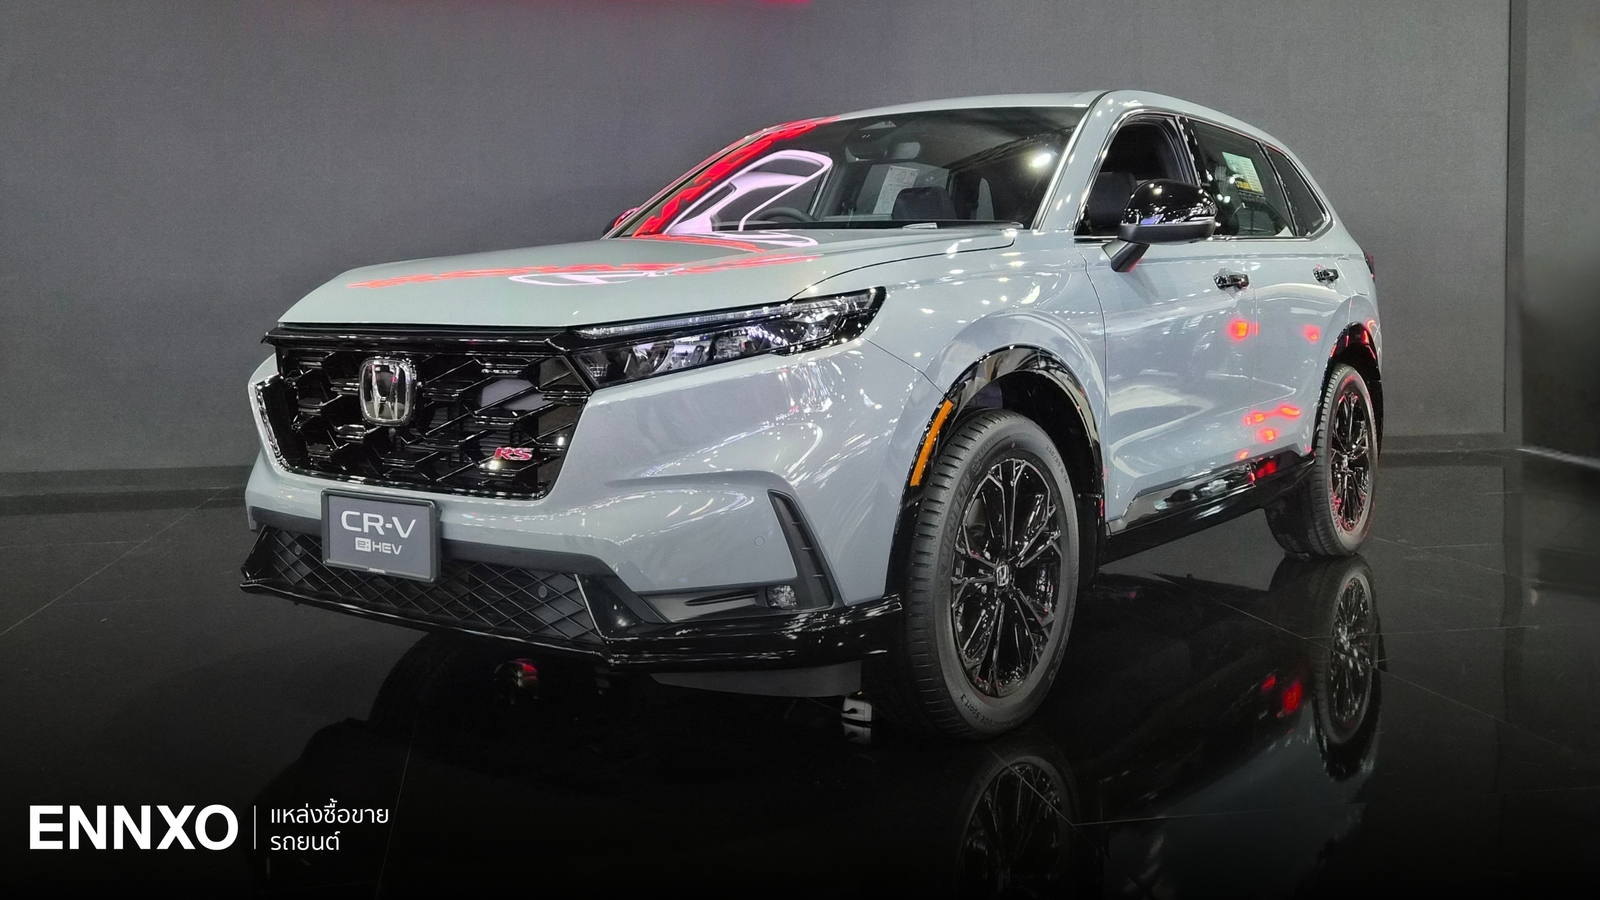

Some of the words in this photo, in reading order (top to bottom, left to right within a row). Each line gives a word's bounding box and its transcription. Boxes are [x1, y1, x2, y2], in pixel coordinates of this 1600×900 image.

[494, 446, 534, 461] RS
[341, 510, 416, 539] CR-V
[965, 701, 981, 720] Sport
